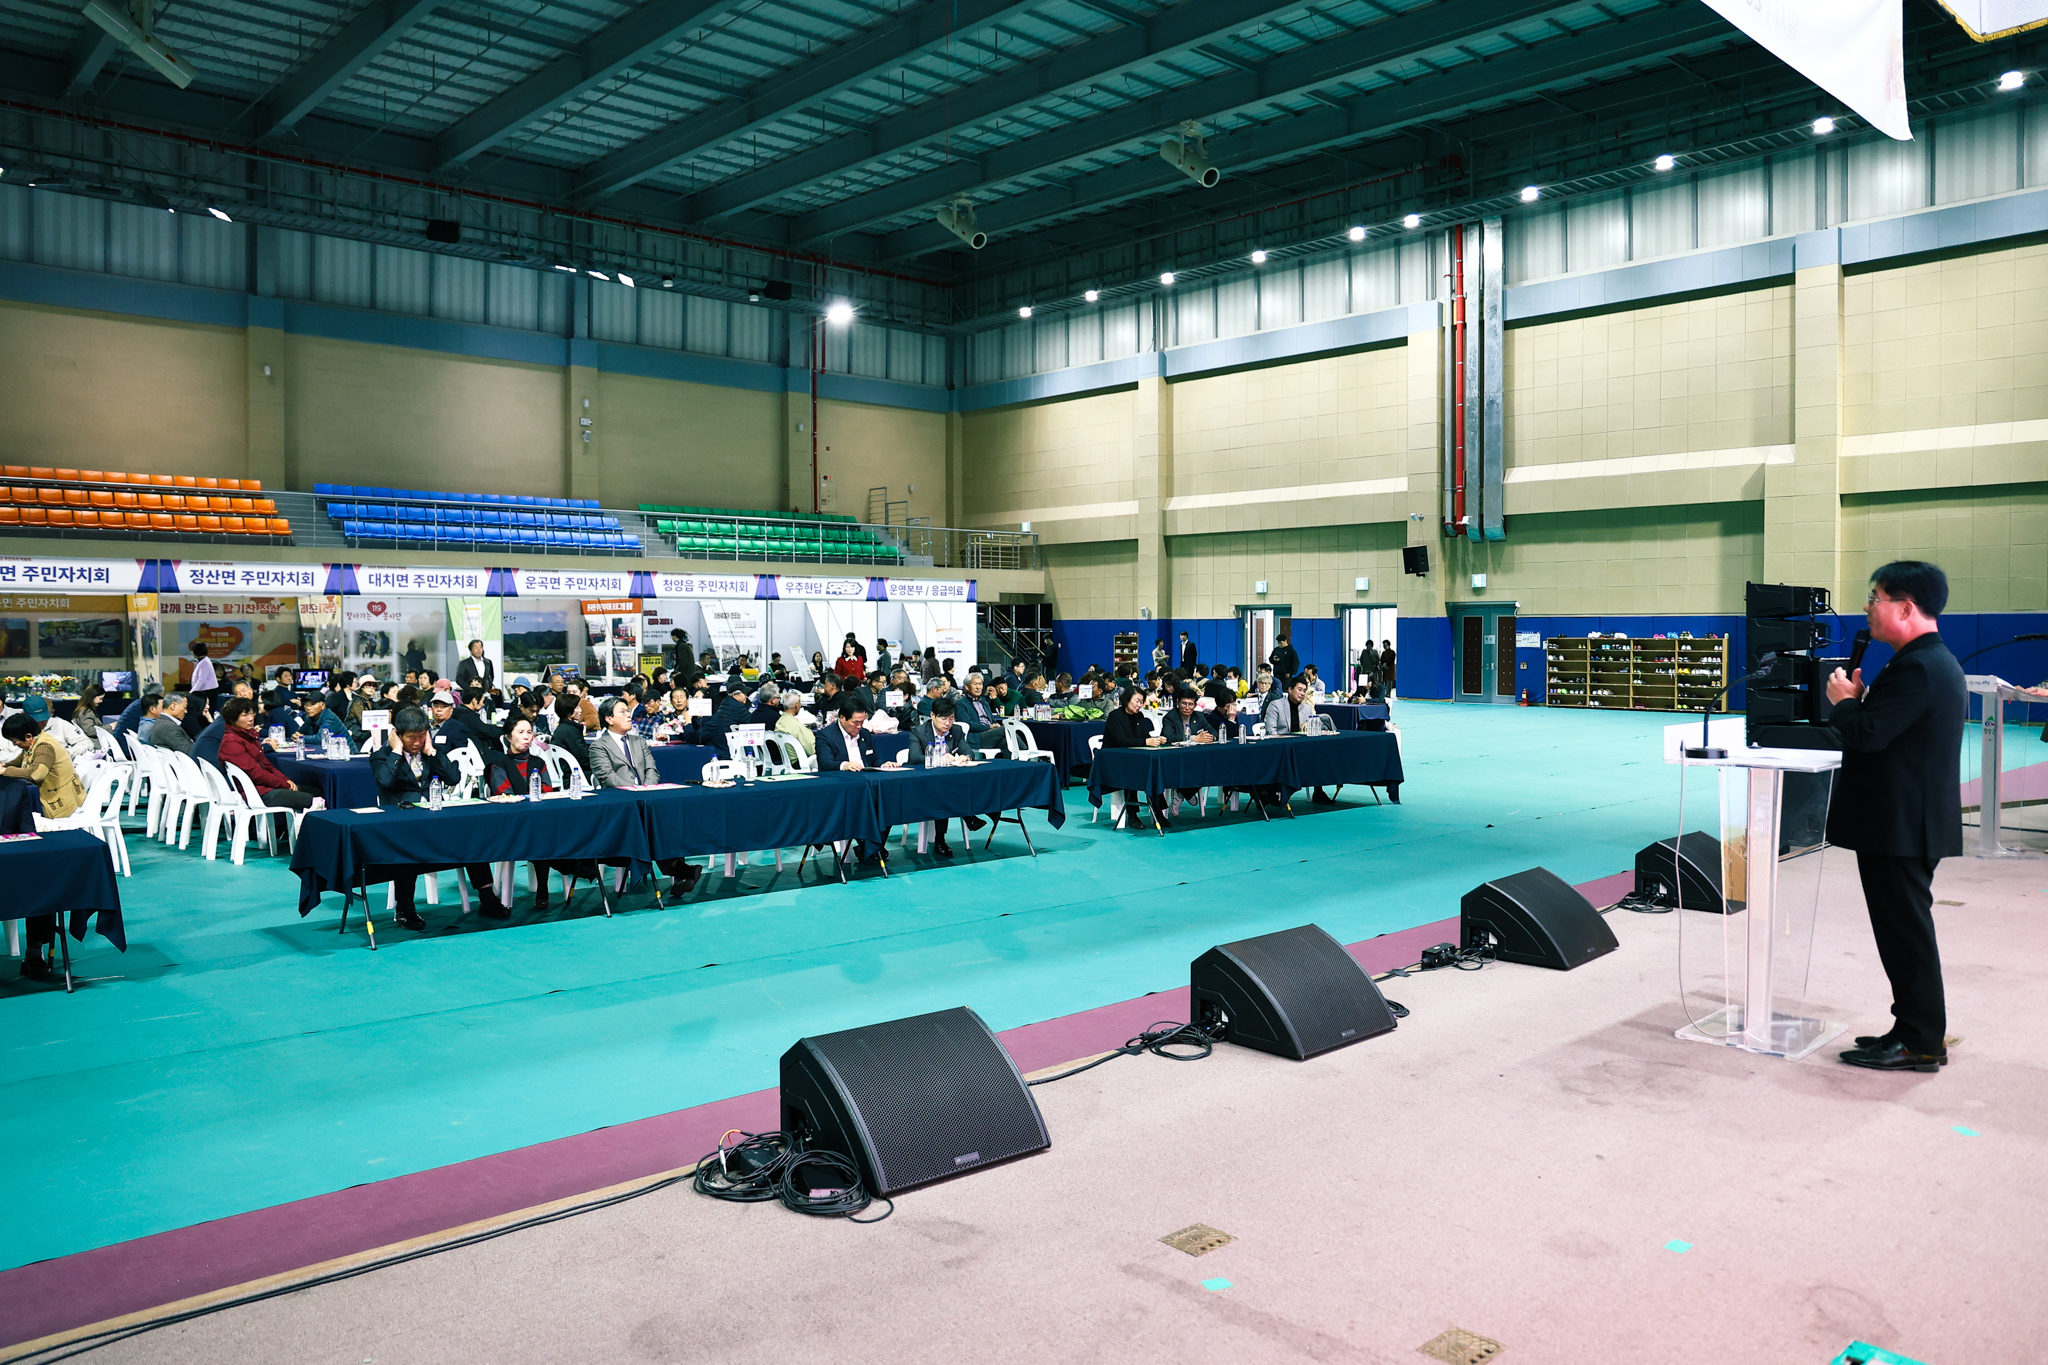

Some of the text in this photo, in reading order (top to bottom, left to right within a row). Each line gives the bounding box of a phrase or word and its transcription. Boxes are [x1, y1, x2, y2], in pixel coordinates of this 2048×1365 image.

[22, 566, 109, 583] 주민자치회
[189, 569, 315, 586] 정산면 주민자치회
[368, 573, 478, 589] 대치면 주민자치회
[525, 576, 622, 591] 운곡면 주민자치회
[662, 579, 748, 593] 청양읍 주민자치회
[785, 581, 823, 595] 우주현답
[889, 584, 924, 596] 운영본부
[931, 585, 964, 597] 응급의료
[16, 597, 70, 609] 주민자치회
[185, 603, 219, 614] 만드는
[223, 603, 255, 614] 활기찬
[372, 604, 382, 612] 119
[346, 612, 372, 621] 찾아가는
